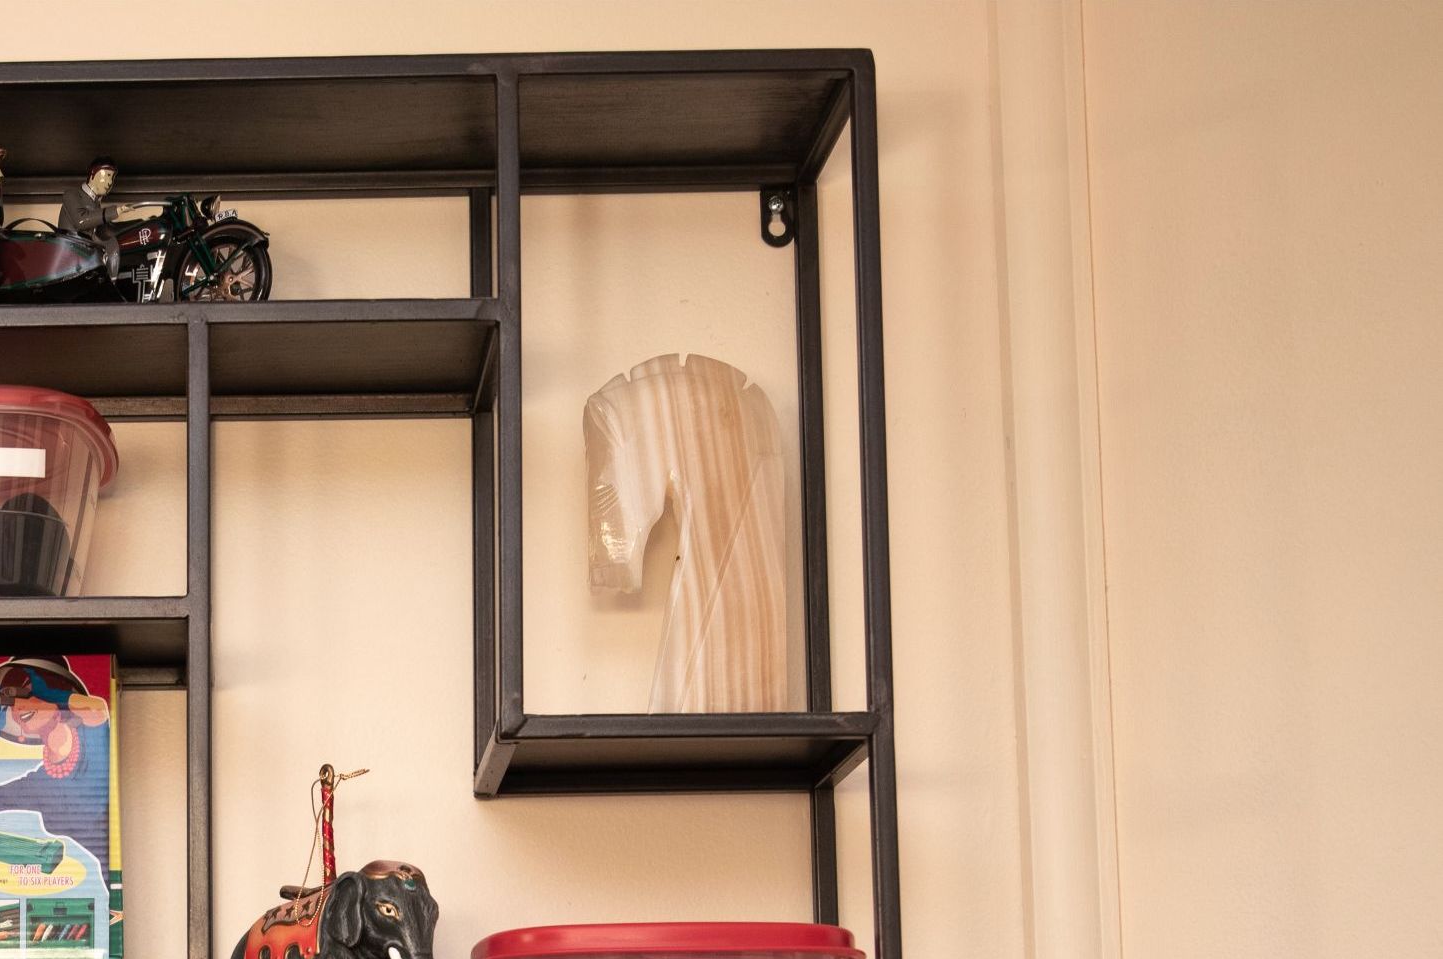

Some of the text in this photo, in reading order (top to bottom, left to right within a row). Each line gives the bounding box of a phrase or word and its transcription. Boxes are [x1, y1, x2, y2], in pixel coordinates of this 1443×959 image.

[10, 864, 41, 874] FOR ONE
[19, 876, 74, 886] TO SIX PLAYERS
